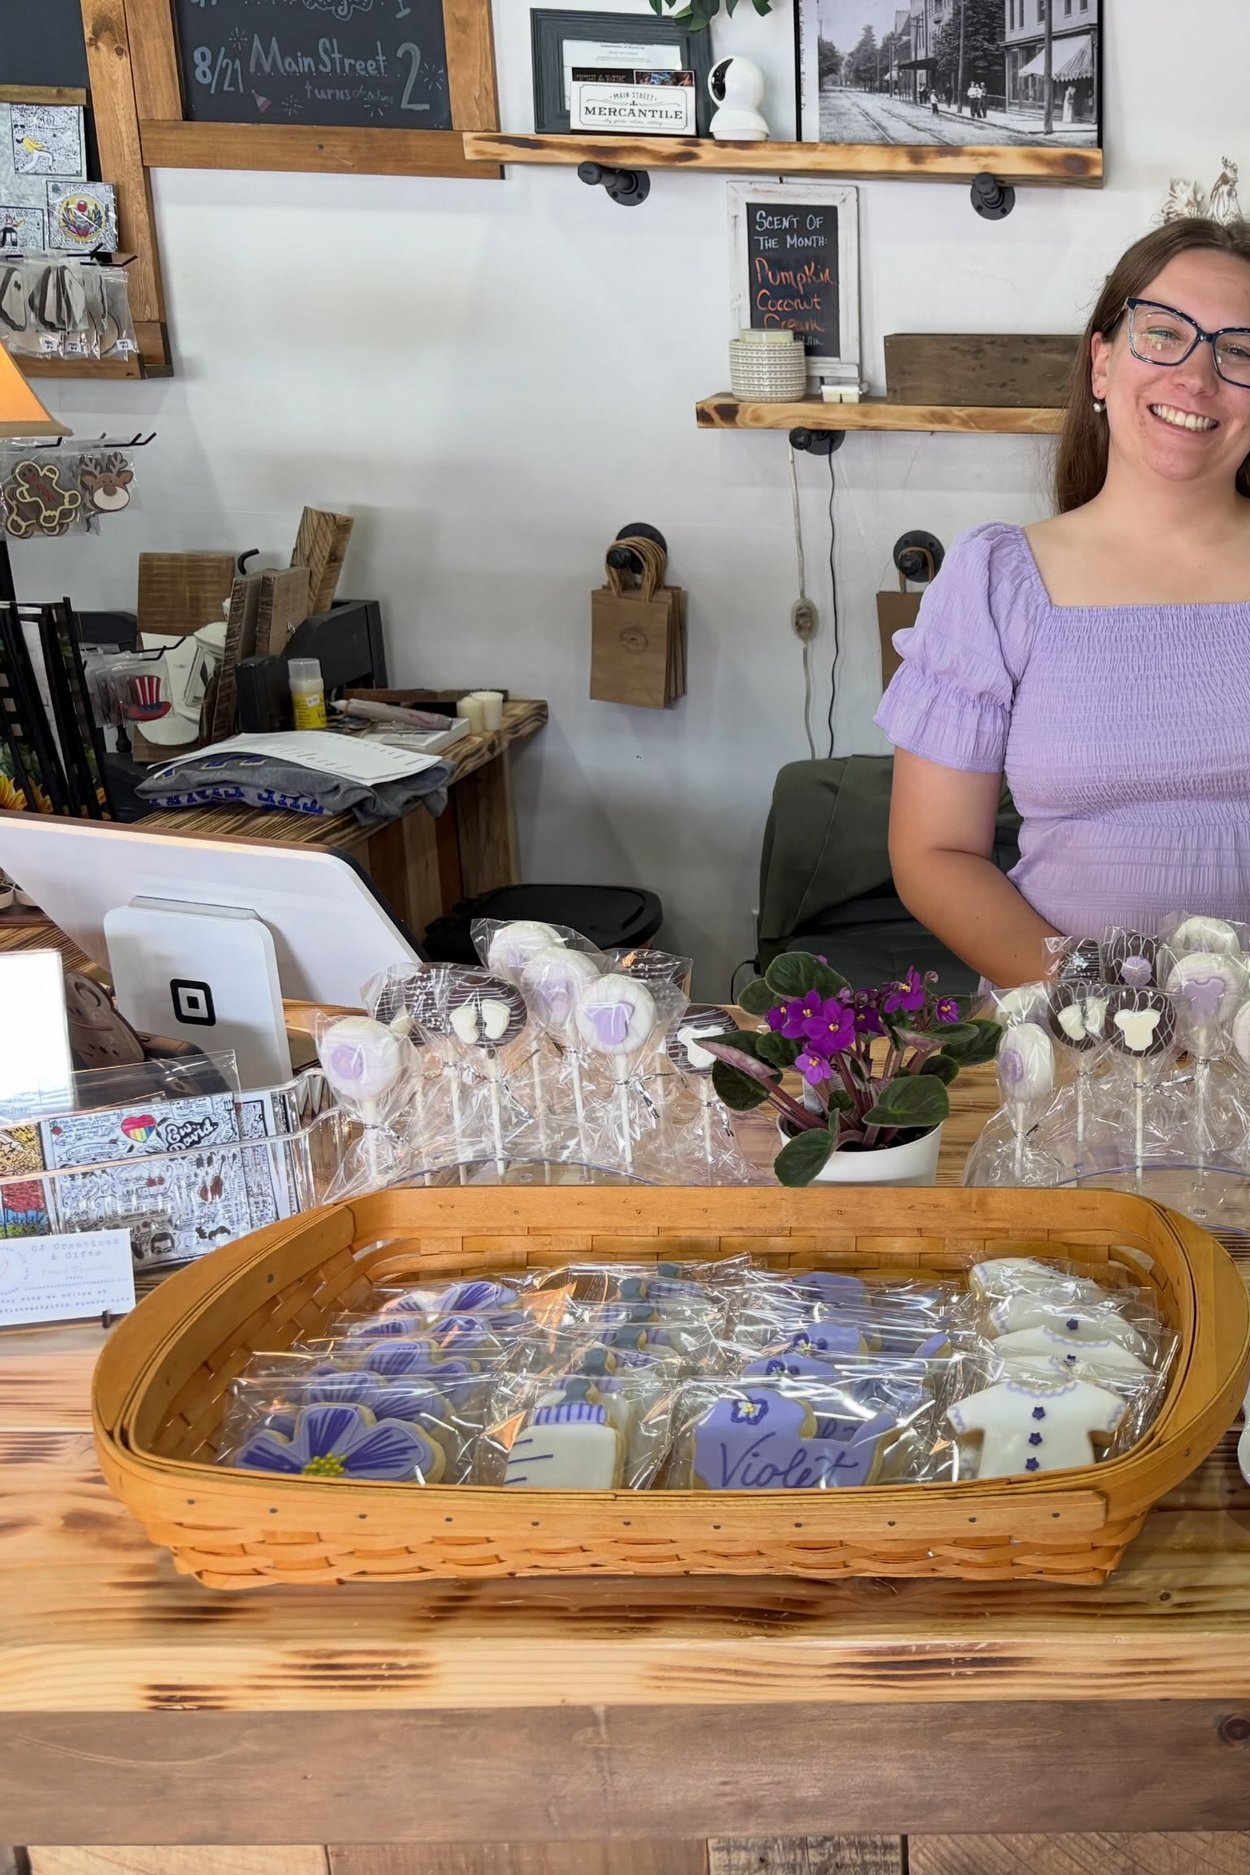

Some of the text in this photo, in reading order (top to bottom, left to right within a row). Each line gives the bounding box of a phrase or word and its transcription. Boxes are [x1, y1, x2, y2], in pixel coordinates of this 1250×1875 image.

[193, 33, 387, 94] 8/21 Main Street
[396, 42, 430, 110] 2
[613, 91, 655, 101] MAIN STREET
[584, 106, 683, 120] MERCANTILE
[755, 210, 824, 231] SCENT OF
[754, 234, 828, 250] THE MONTH:
[756, 289, 822, 311] Coconut
[719, 1431, 859, 1489] Violet
